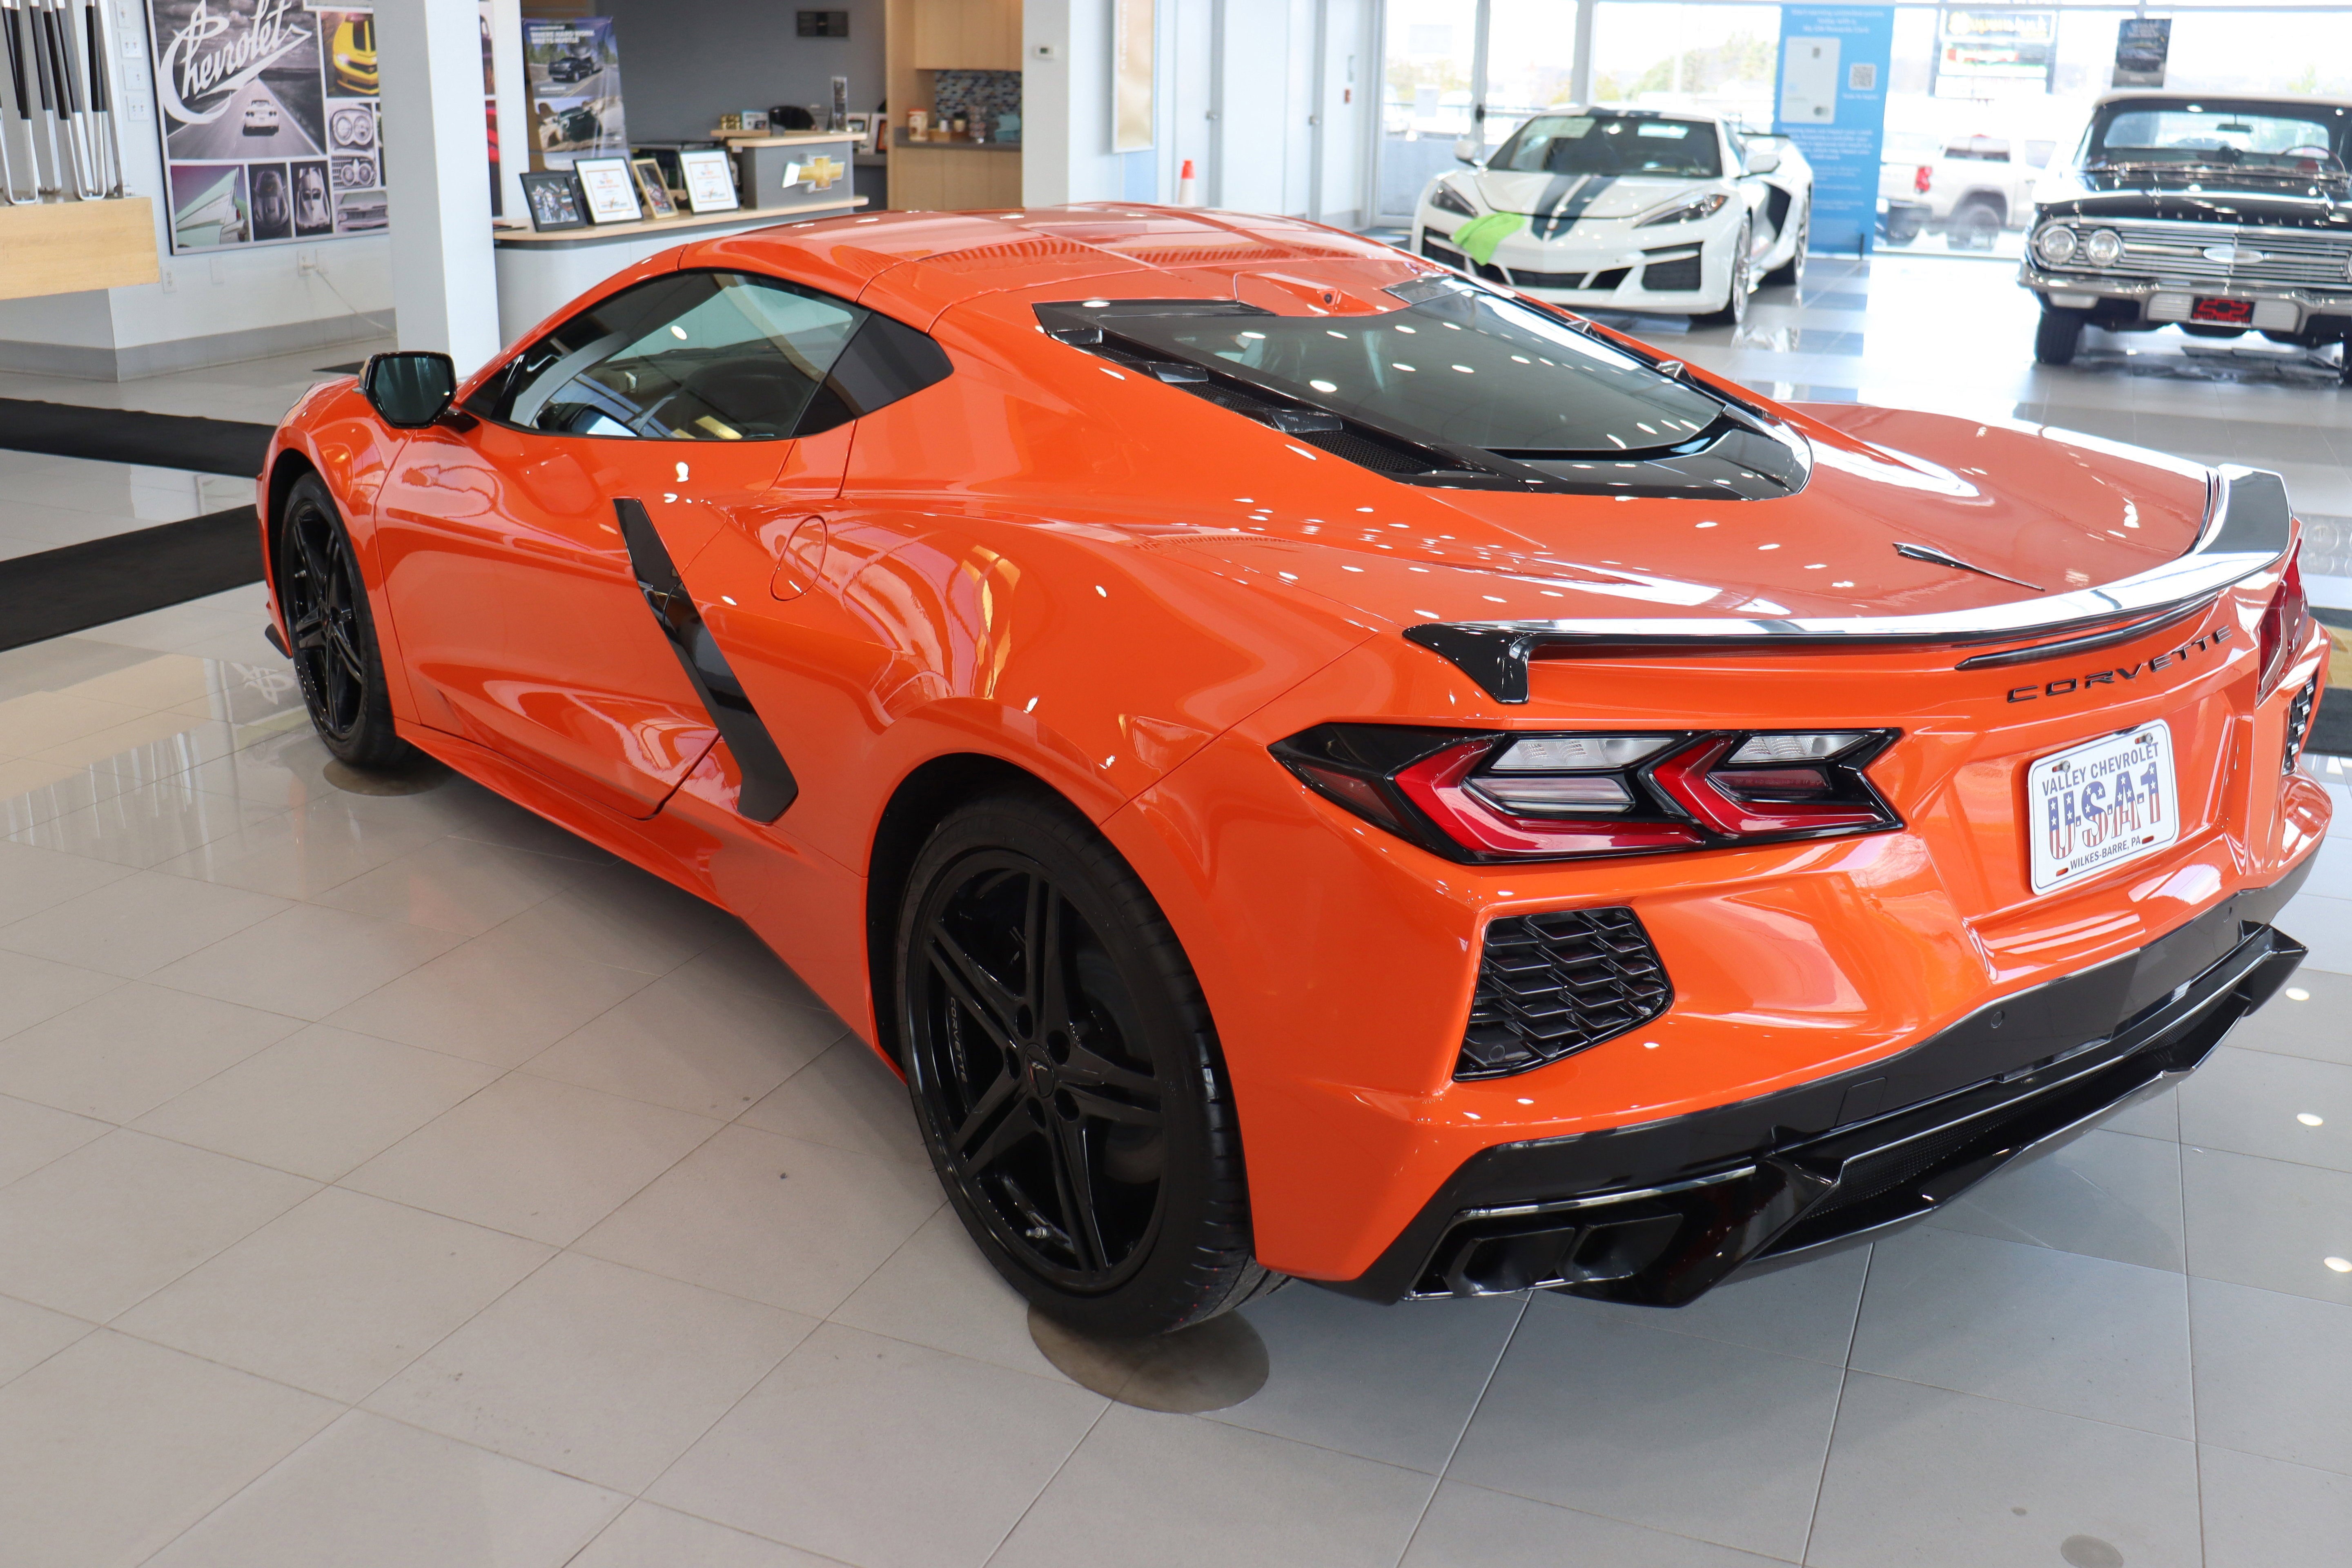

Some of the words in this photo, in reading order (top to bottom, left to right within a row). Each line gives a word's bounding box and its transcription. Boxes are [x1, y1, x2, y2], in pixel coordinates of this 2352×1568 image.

[160, 0, 312, 124] Chevrolet
[2007, 625, 2233, 703] CORVETTE
[2042, 766, 2086, 796] VALLEY
[2090, 742, 2160, 779] CHEVROLET
[2070, 840, 2129, 870] WILKES-BARRE,
[2131, 835, 2140, 847] PA
[951, 997, 968, 1082] CORVETTE
